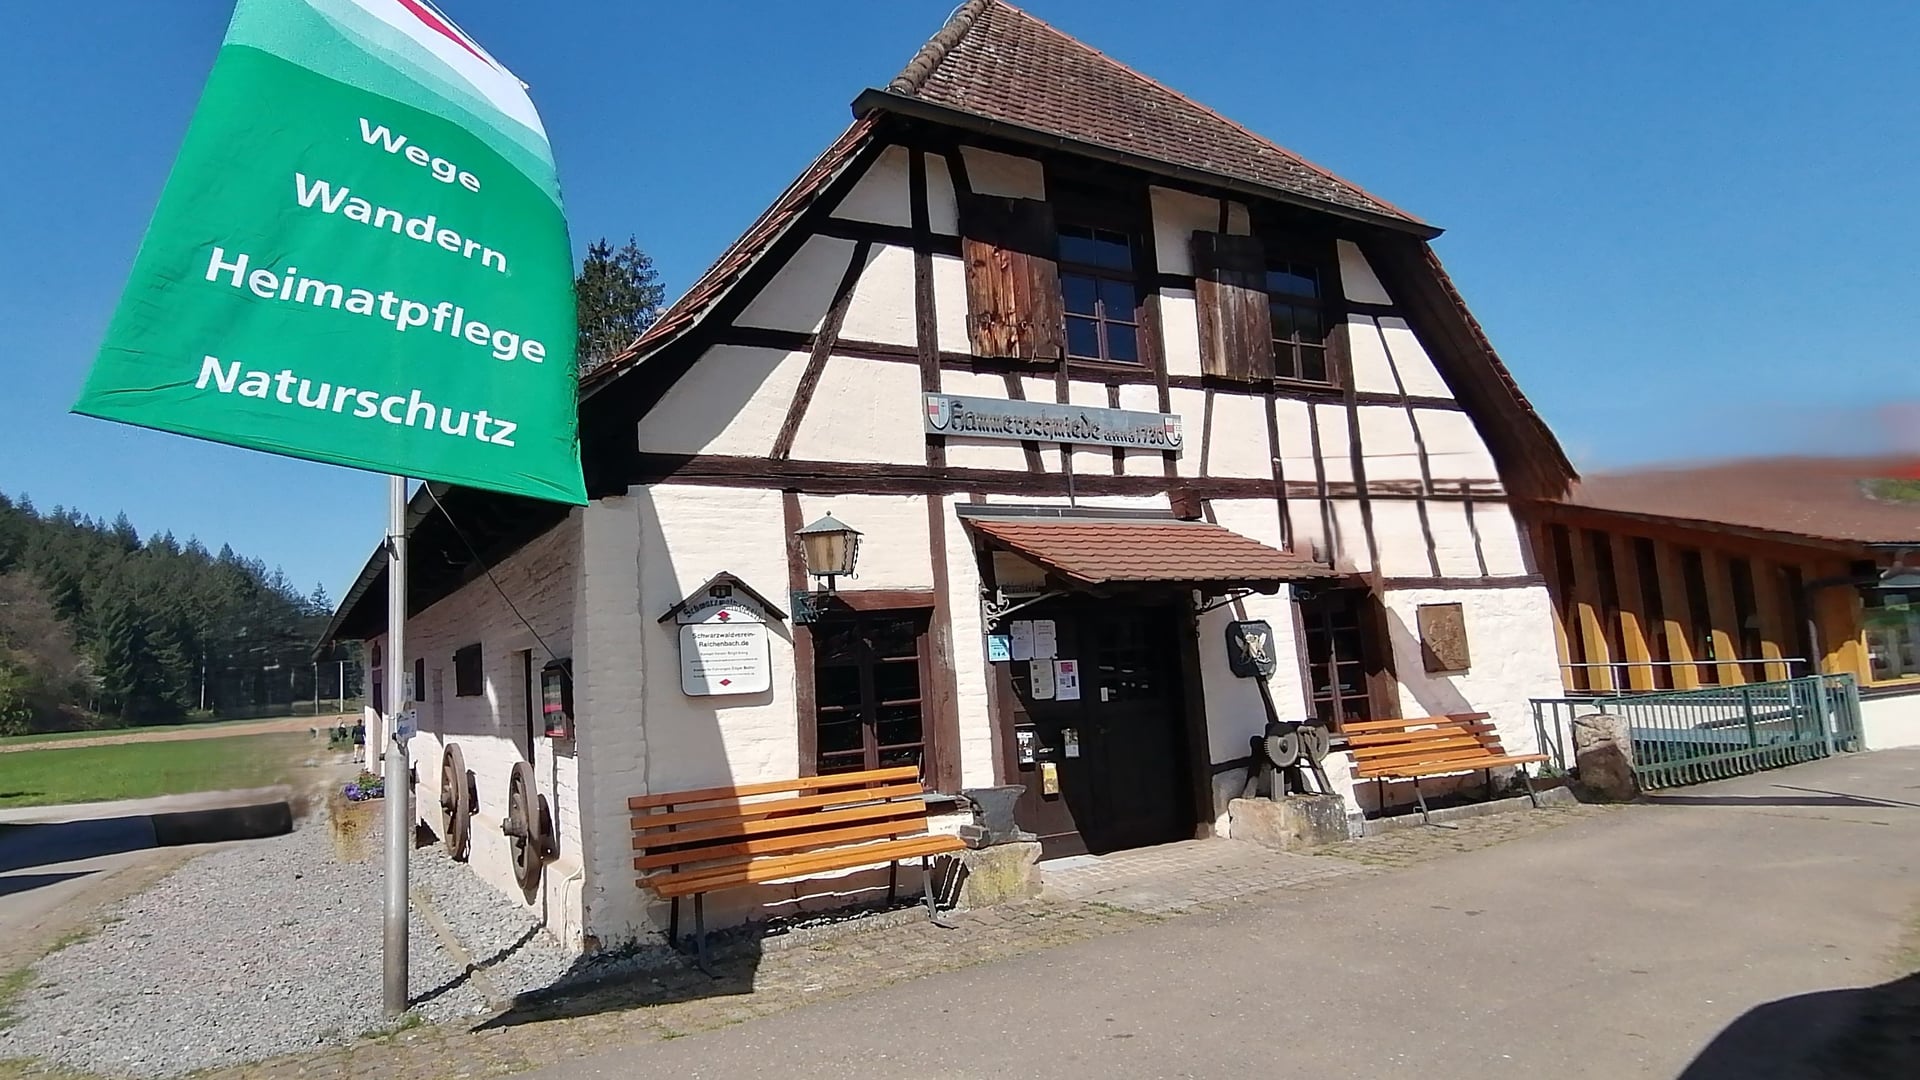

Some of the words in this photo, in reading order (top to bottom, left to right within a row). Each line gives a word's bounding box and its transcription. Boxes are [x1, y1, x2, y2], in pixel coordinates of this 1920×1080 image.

[358, 117, 481, 193] Wege
[295, 172, 507, 273] Wandern
[205, 246, 546, 363] Heimatpflege
[195, 355, 517, 447] Naturschutz
